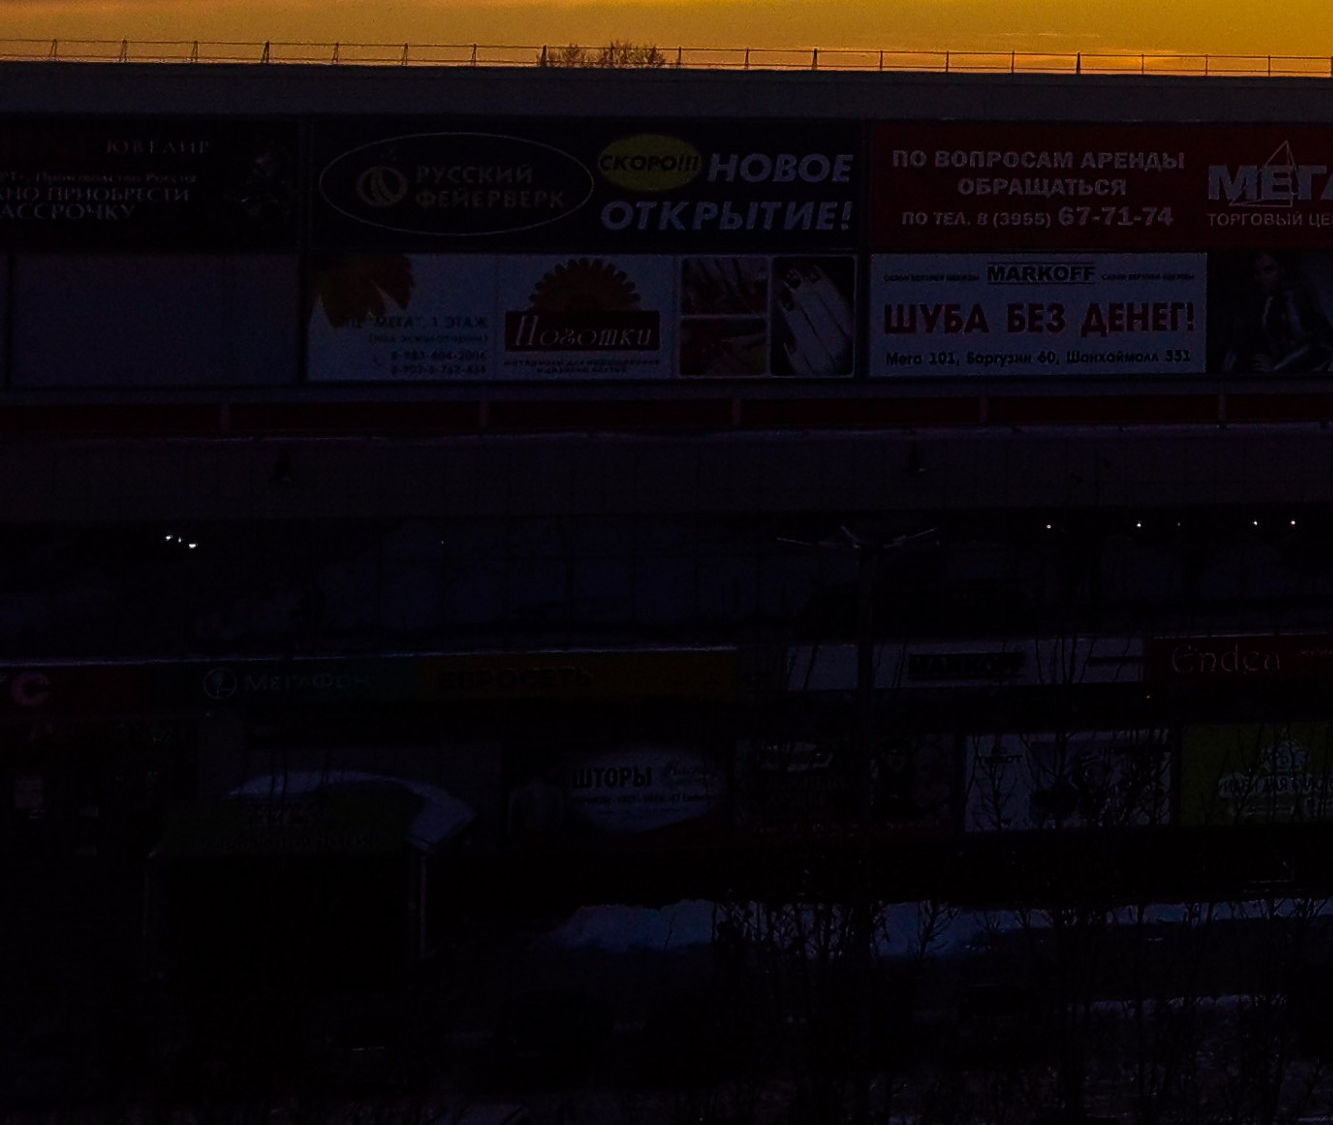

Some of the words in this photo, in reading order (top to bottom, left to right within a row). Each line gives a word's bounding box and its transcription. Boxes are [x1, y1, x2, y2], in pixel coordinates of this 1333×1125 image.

[600, 155, 699, 171] СКОРО!!!
[707, 152, 854, 183] НОВОЕ
[892, 151, 928, 169] ПО
[934, 151, 1074, 169] ВОПРОСАМ
[1080, 152, 1186, 173] АРЕНДЫ
[416, 163, 534, 184] РУССКИЙ
[957, 178, 1127, 196] ОБРАЩАТЬСЯ
[415, 188, 564, 209] ФЕЙЕРВЕРК
[601, 200, 853, 231] ОТКРЫТИЕ!
[901, 212, 927, 226] ПО
[933, 212, 971, 226] ТЕЛ.
[1058, 206, 1175, 227] 67-71-74
[1208, 212, 1304, 226] ТОРГОВЫЙ
[987, 266, 1095, 282] MARKOFF
[884, 303, 990, 335] ШУБА
[1007, 303, 1066, 334] БЕЗ
[1081, 301, 1194, 337] ДЕНЕГ!
[514, 315, 652, 347] Ноготки
[886, 352, 920, 365] Мега
[967, 351, 1033, 368] Баргузин
[573, 766, 652, 788] ШТОРЫ
